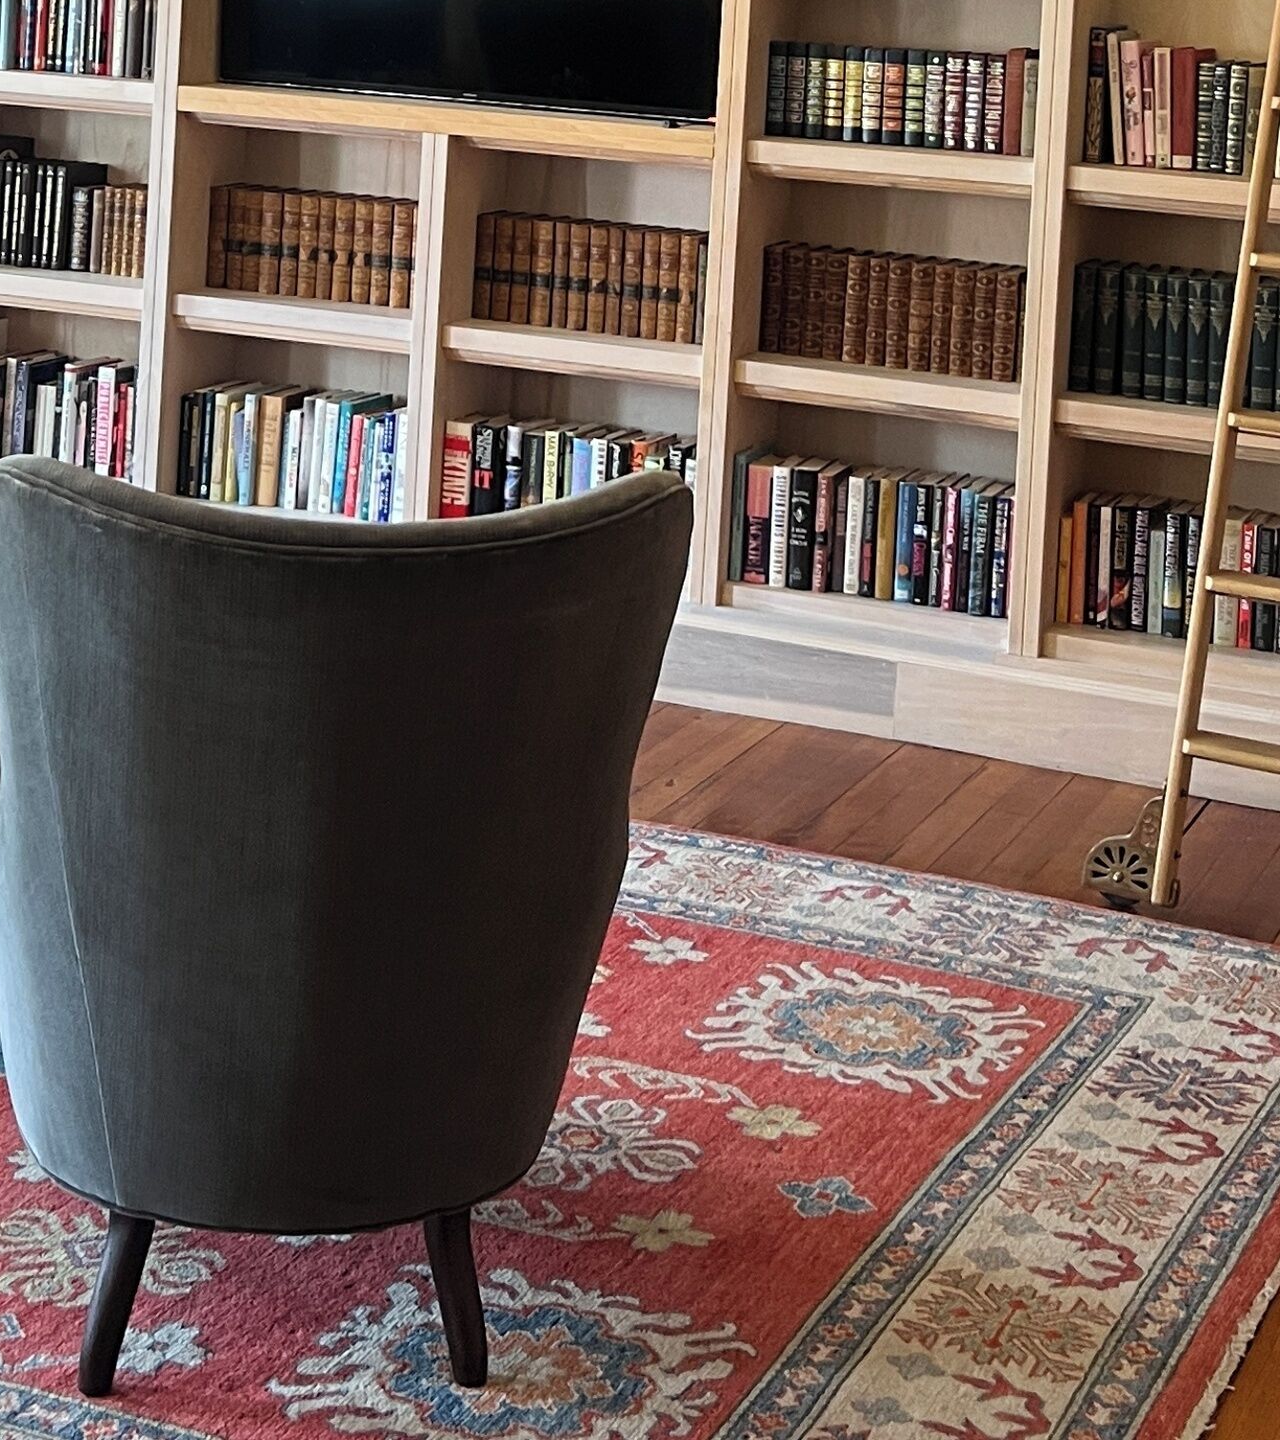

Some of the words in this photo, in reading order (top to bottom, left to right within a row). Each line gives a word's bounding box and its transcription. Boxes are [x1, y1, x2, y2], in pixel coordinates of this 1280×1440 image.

[98, 382, 111, 421] PUBLIC
[94, 423, 109, 465] ENEMIES
[547, 435, 557, 457] MAX
[441, 454, 469, 506] KING
[774, 475, 788, 507] STEPHEN
[977, 502, 989, 525] THE
[747, 517, 763, 566] JACKIE
[975, 527, 988, 554] FIRM
